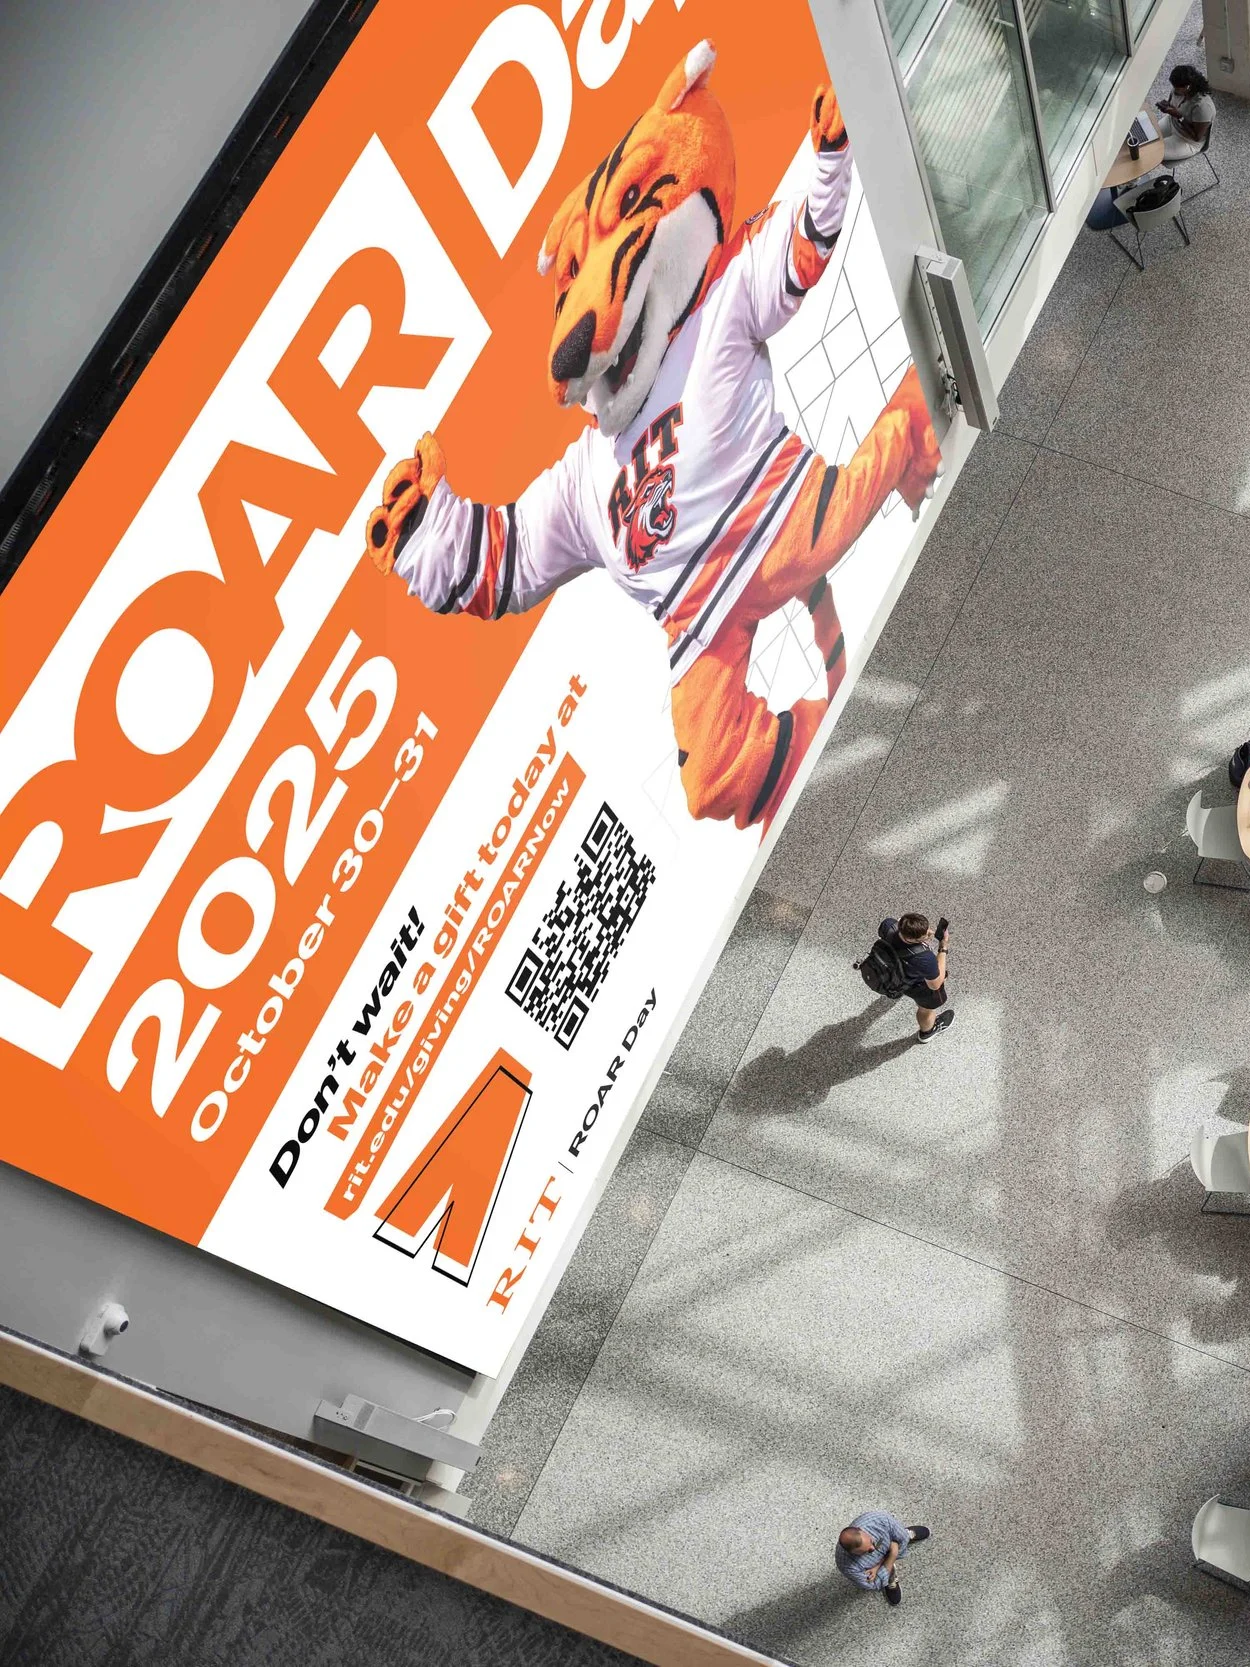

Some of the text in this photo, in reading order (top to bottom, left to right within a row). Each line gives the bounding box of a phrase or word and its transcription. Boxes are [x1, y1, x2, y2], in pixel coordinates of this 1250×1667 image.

[0, 0, 686, 1008] ROAR Da
[607, 402, 684, 549] RIT
[105, 629, 398, 1118] 2025
[190, 894, 335, 1142] October
[327, 675, 588, 1141] Make a gift today at
[343, 778, 570, 1202] rit.edu/giving/ROARNow
[352, 905, 426, 1036] wait!
[486, 987, 657, 1314] RIT ROAR Day
